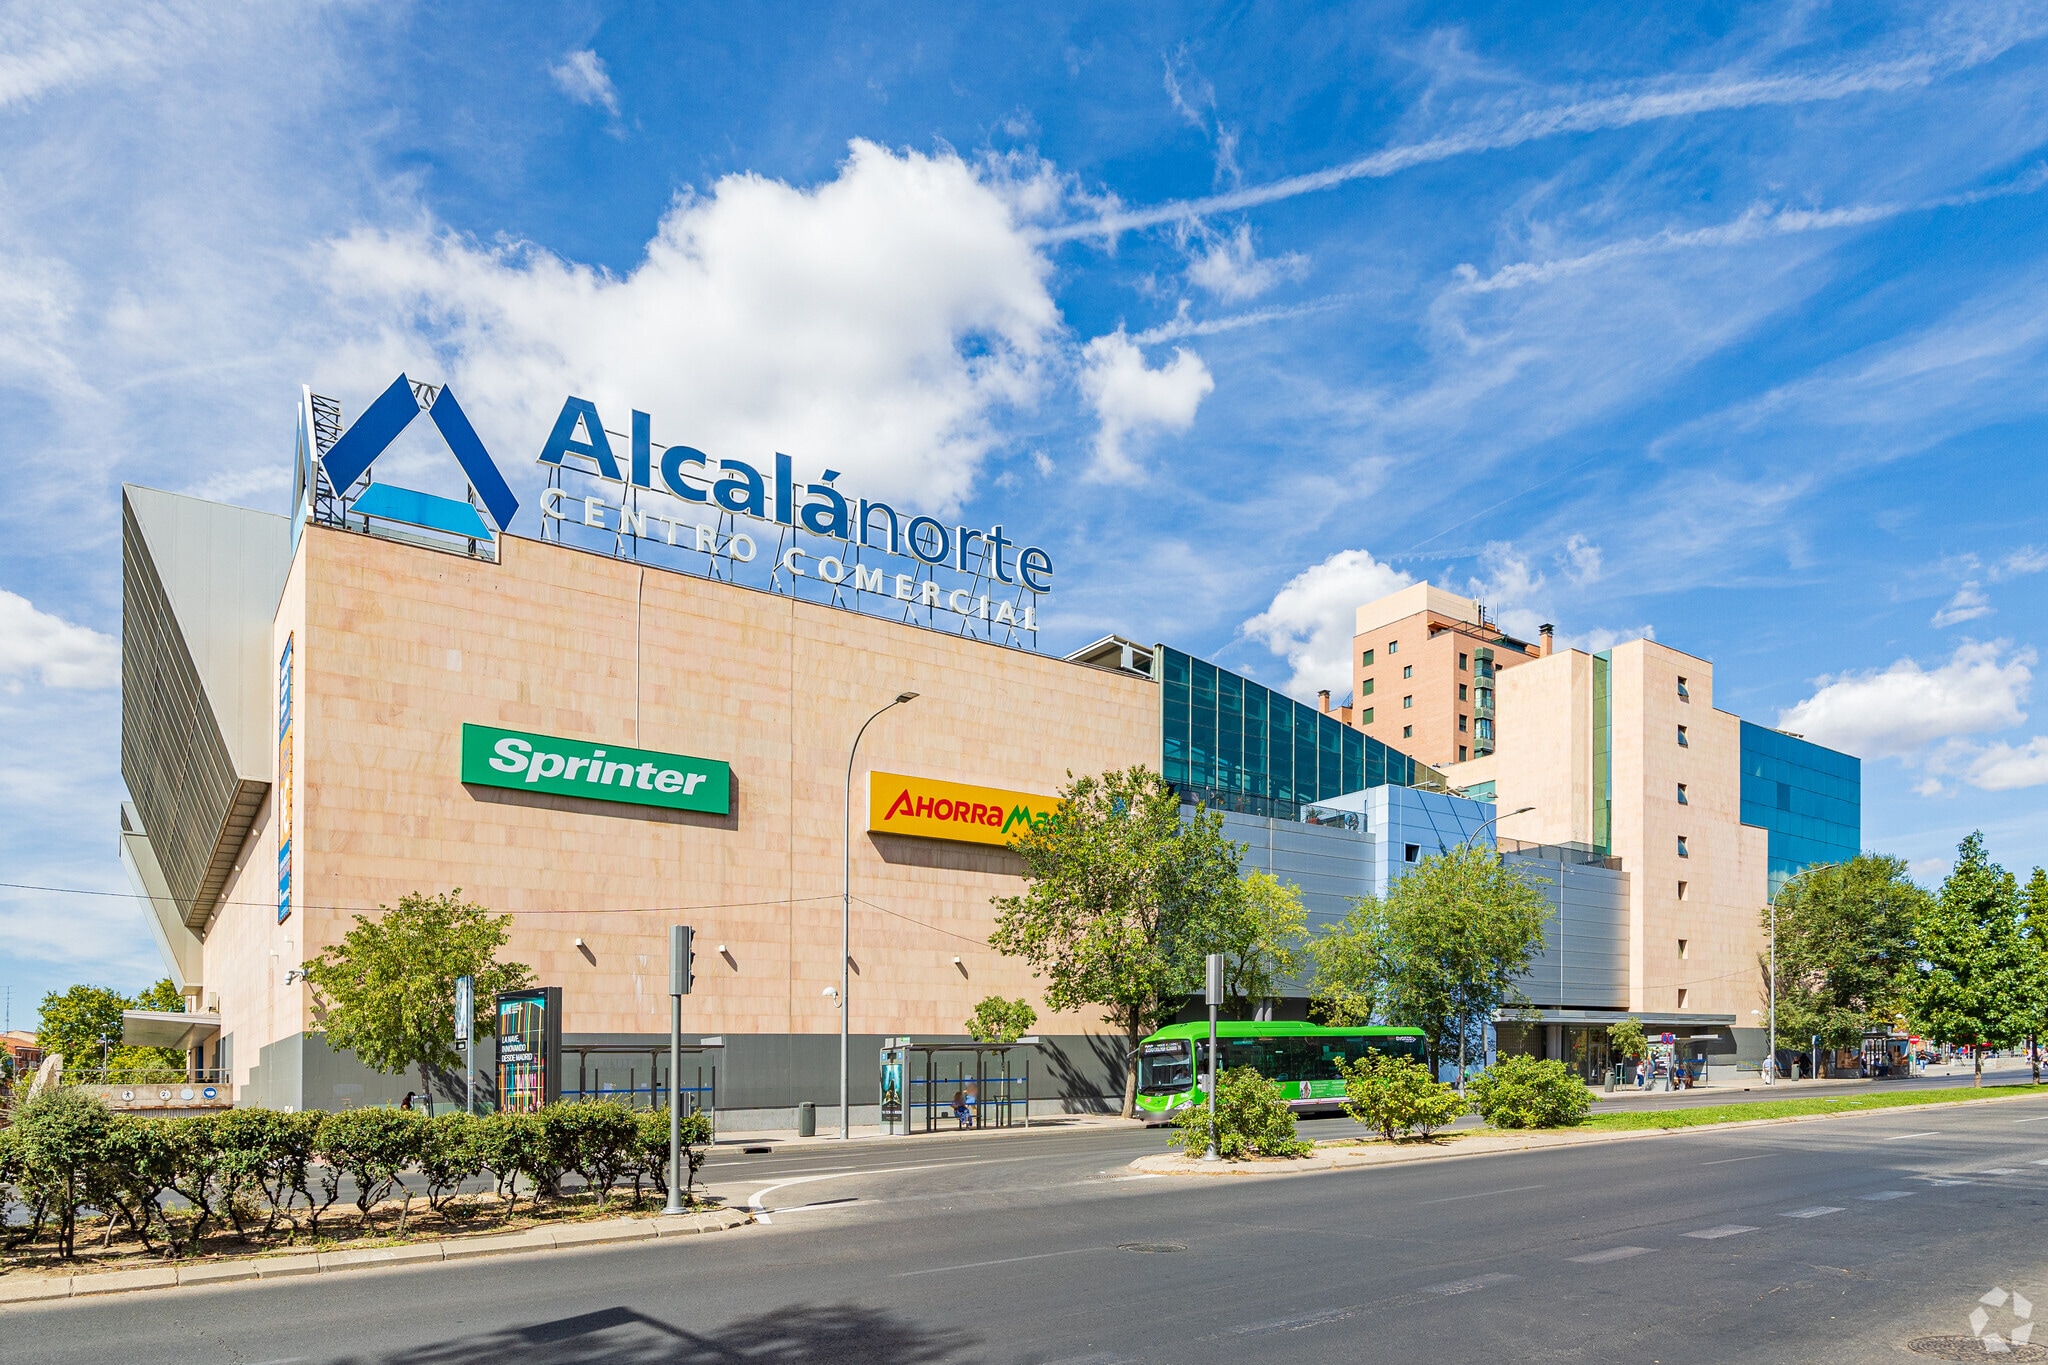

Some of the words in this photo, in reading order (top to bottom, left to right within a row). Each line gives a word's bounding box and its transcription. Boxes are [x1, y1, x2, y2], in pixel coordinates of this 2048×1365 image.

[536, 395, 1054, 595] Alcalánorte
[540, 488, 757, 563] CENTRO
[783, 547, 1040, 632] COMERCIAL
[488, 737, 707, 797] Sprinter
[501, 1054, 516, 1063] DESDE
[516, 1053, 533, 1062] MADRID
